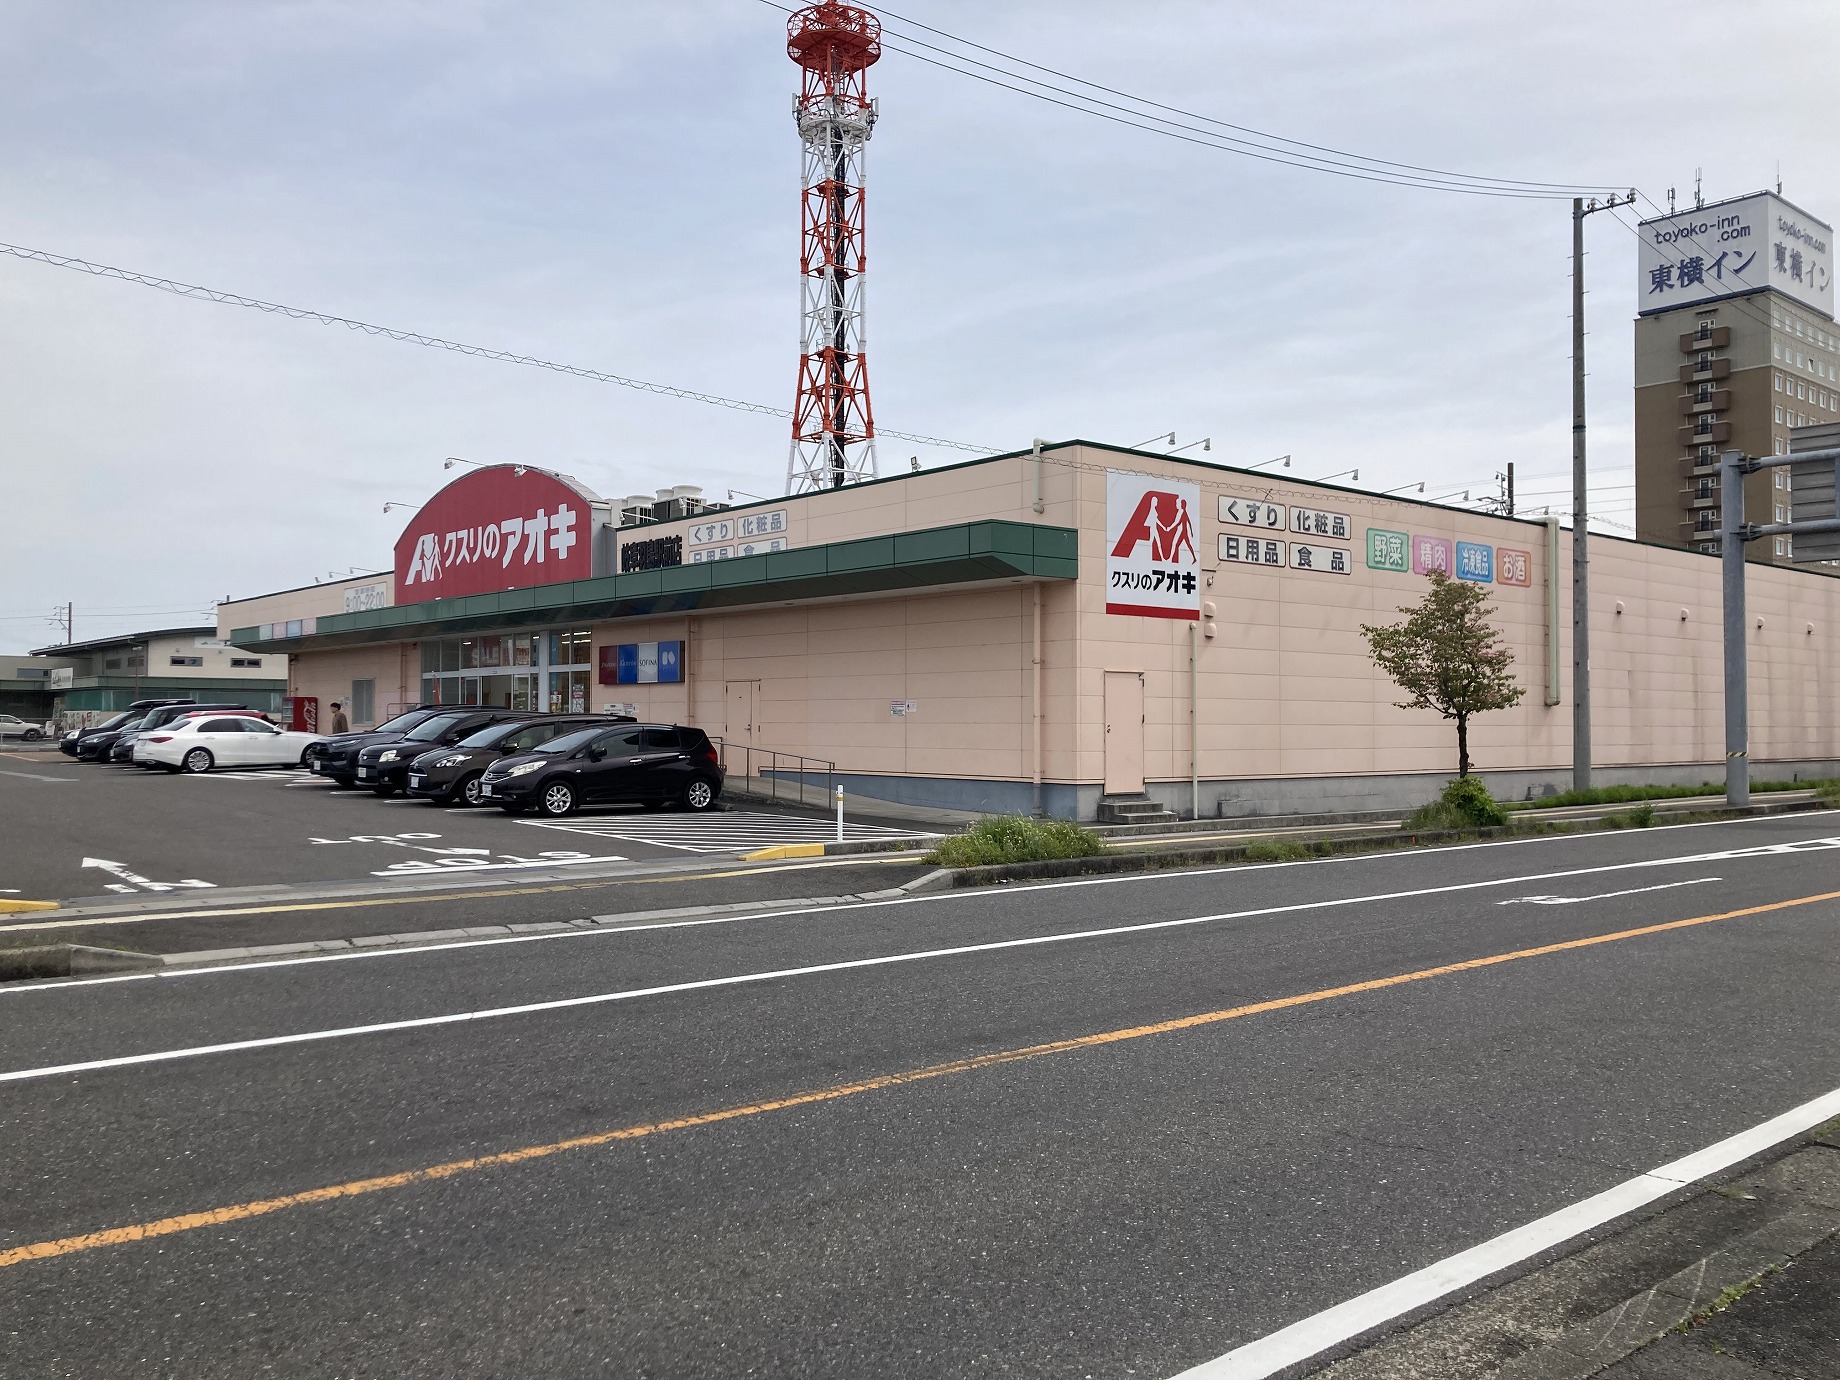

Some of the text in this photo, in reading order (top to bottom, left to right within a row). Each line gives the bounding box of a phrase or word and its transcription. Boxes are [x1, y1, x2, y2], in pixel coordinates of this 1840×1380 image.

[1654, 214, 1740, 244] toyoko-inn
[1716, 225, 1751, 243] .com
[1648, 250, 1757, 295] 東横イン
[1773, 241, 1831, 292] 東横イン
[742, 512, 782, 536] 化粧品
[1227, 500, 1278, 527] くすり
[1296, 509, 1345, 537] 化粧品
[443, 503, 577, 569] クスリのアオキ
[694, 522, 728, 541] くすり
[1226, 537, 1279, 564] 日用品
[1297, 546, 1345, 572] 食品
[1374, 533, 1403, 565] 野菜
[1419, 541, 1447, 570] 精肉
[1461, 548, 1490, 576] 冷凍食品
[1503, 553, 1526, 580] お酒
[1111, 569, 1197, 595] クスリのアオキ
[639, 658, 658, 667] SOFINA
[387, 851, 591, 870] STOP
